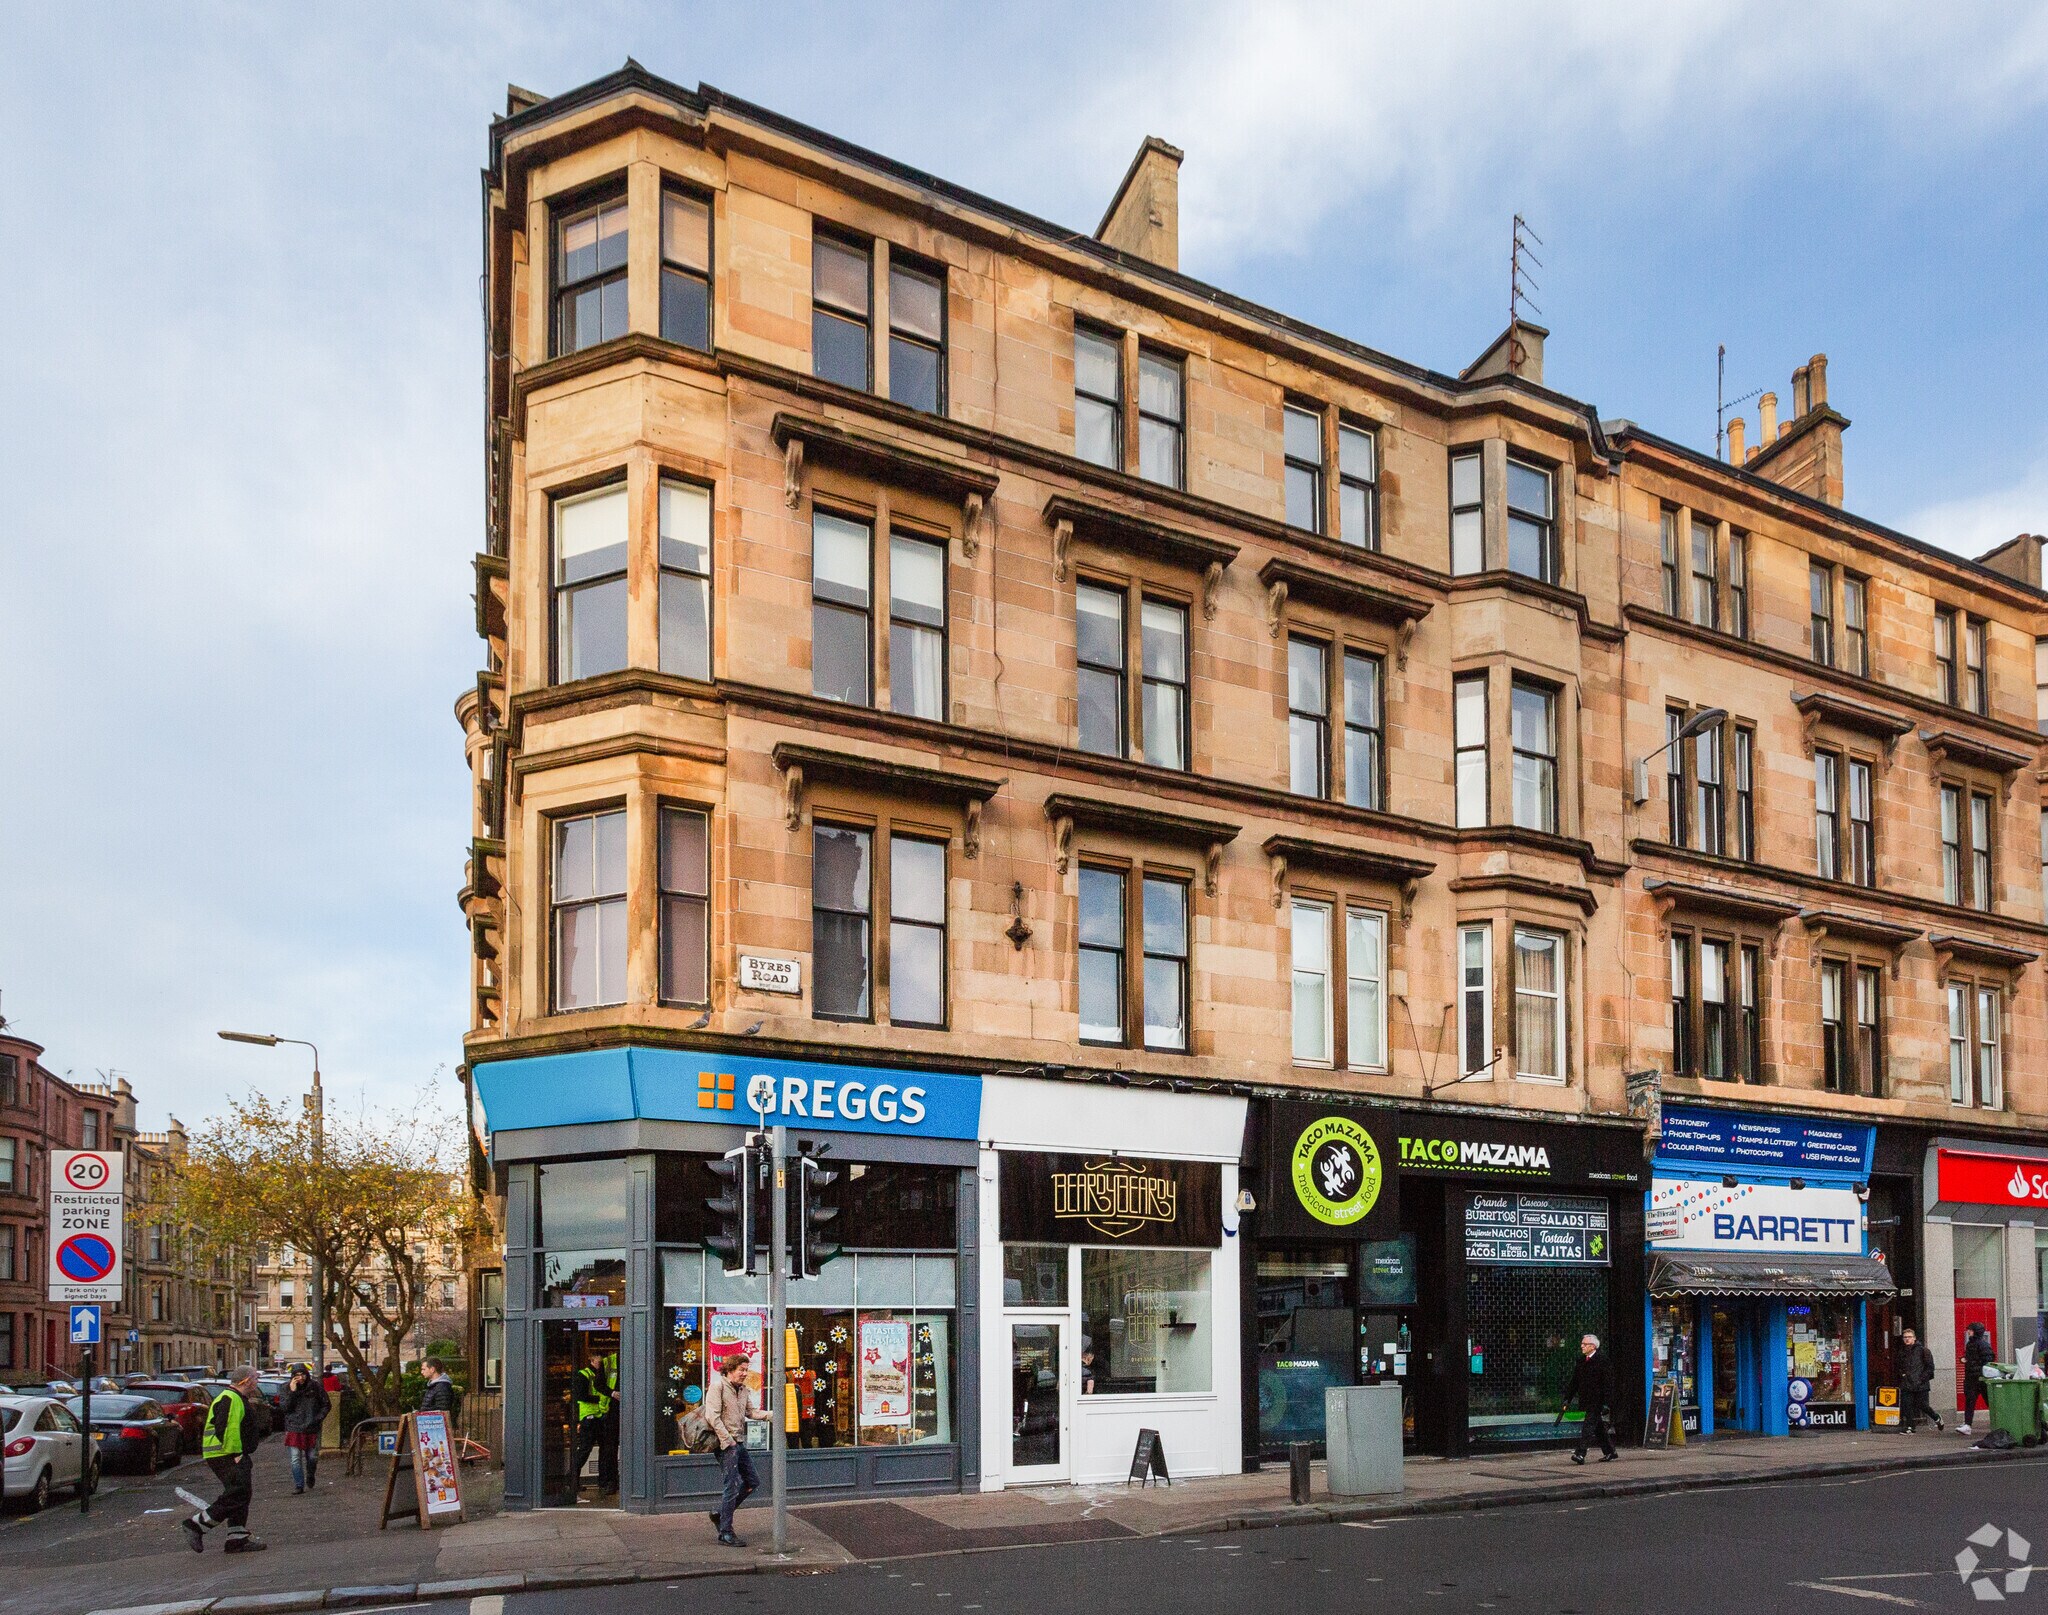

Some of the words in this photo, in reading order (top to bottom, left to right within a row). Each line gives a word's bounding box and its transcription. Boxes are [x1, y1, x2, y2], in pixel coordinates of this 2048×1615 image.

[749, 958, 791, 972] BYRES
[752, 970, 788, 983] ROAD
[747, 1074, 926, 1124] GREGGS
[1669, 1118, 1710, 1127] STATIONERY
[1738, 1124, 1780, 1133] NEWSPAPERS
[1668, 1130, 1692, 1139] PHONE
[1693, 1132, 1721, 1140] TOP-UPS
[1808, 1130, 1842, 1139] MAGAZINES
[1298, 1128, 1323, 1159] TACO
[1325, 1123, 1374, 1164] MAZAMA
[1737, 1136, 1762, 1144] STAMPS
[1770, 1138, 1798, 1147] LOTTERY
[1807, 1142, 1836, 1150] GREETING
[1667, 1143, 1694, 1151] COLOUR
[1696, 1145, 1725, 1153] PRINTING
[1736, 1148, 1783, 1158] PHOTOCOPYING
[73, 1164, 103, 1179] 20
[54, 1195, 120, 1205] Restricted
[1298, 1174, 1331, 1217] mexican
[1334, 1201, 1364, 1218] street
[1361, 1177, 1376, 1203] food
[1520, 1196, 1548, 1207] Caseoso
[1474, 1195, 1507, 1209] Grande
[62, 1207, 110, 1217] parking
[1466, 1209, 1516, 1222] BURRITOS
[62, 1218, 110, 1229] ZONE
[1522, 1214, 1540, 1222] Fresco
[1540, 1213, 1584, 1226] SALADS
[1492, 1229, 1528, 1238] NACHOS
[1714, 1214, 1855, 1243] BARRETT
[1540, 1230, 1574, 1244] Tostado
[1466, 1248, 1496, 1256] TACOS
[1534, 1245, 1582, 1258] FAJITAS
[715, 1327, 758, 1337] Christmas
[865, 1334, 905, 1345] Christmas
[1683, 1416, 1697, 1430] rald
[1806, 1411, 1847, 1425] Herald
[385, 1437, 395, 1448] P
